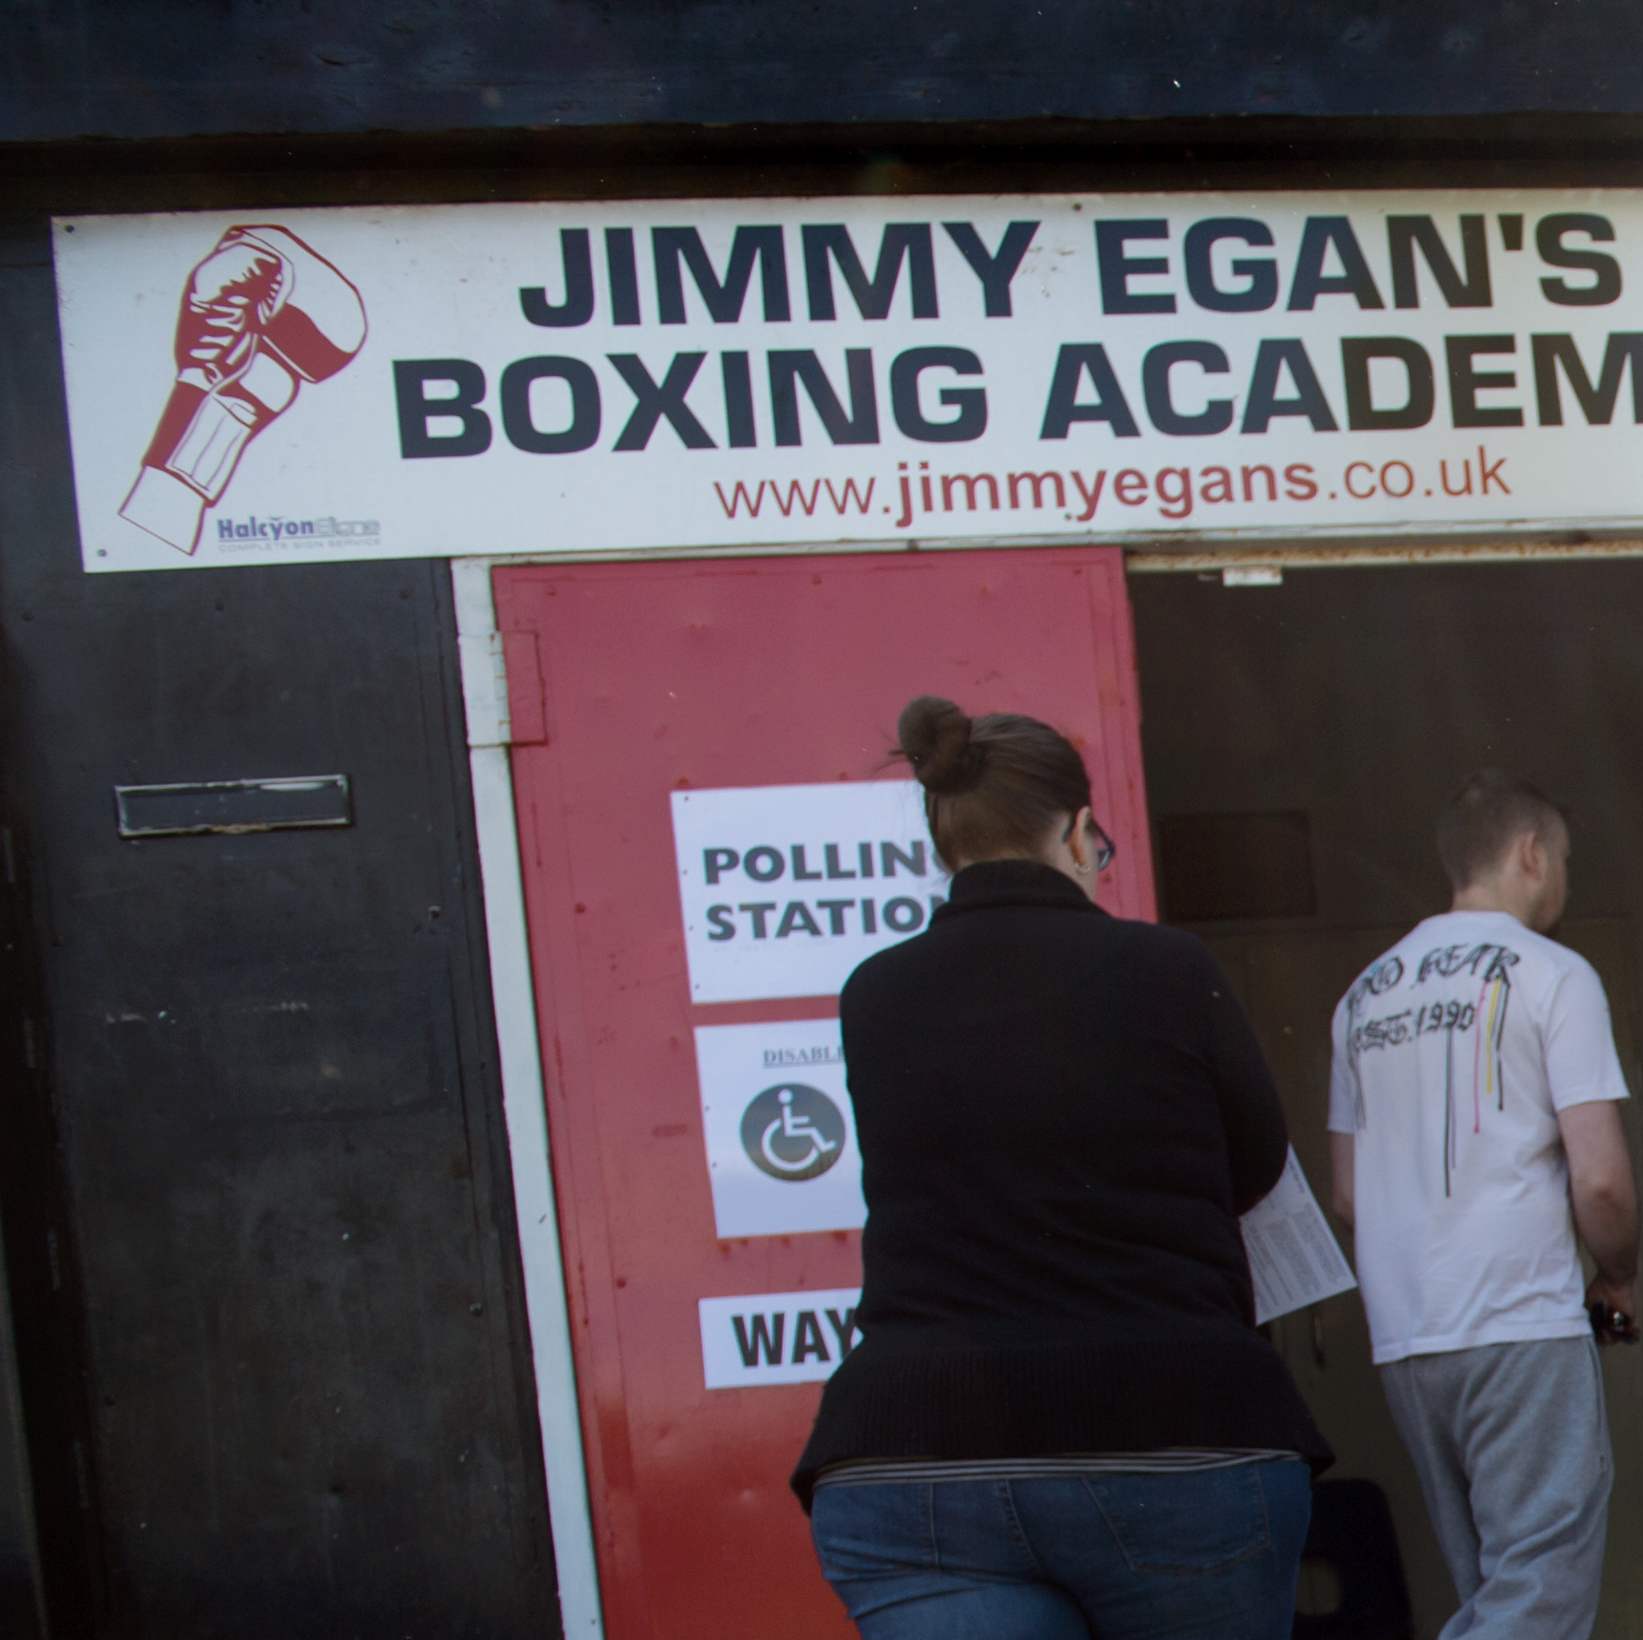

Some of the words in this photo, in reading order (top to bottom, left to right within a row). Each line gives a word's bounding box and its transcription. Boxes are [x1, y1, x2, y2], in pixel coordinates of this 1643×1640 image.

[520, 221, 1040, 328] JIMMY
[1094, 213, 1622, 315] EGAN'S
[392, 346, 987, 460] BOXING
[715, 446, 1511, 527] www.jimmyegans.co.uk
[217, 515, 314, 541] Halcyon
[704, 840, 936, 885] POLLIN
[731, 1307, 857, 1367] WAY
